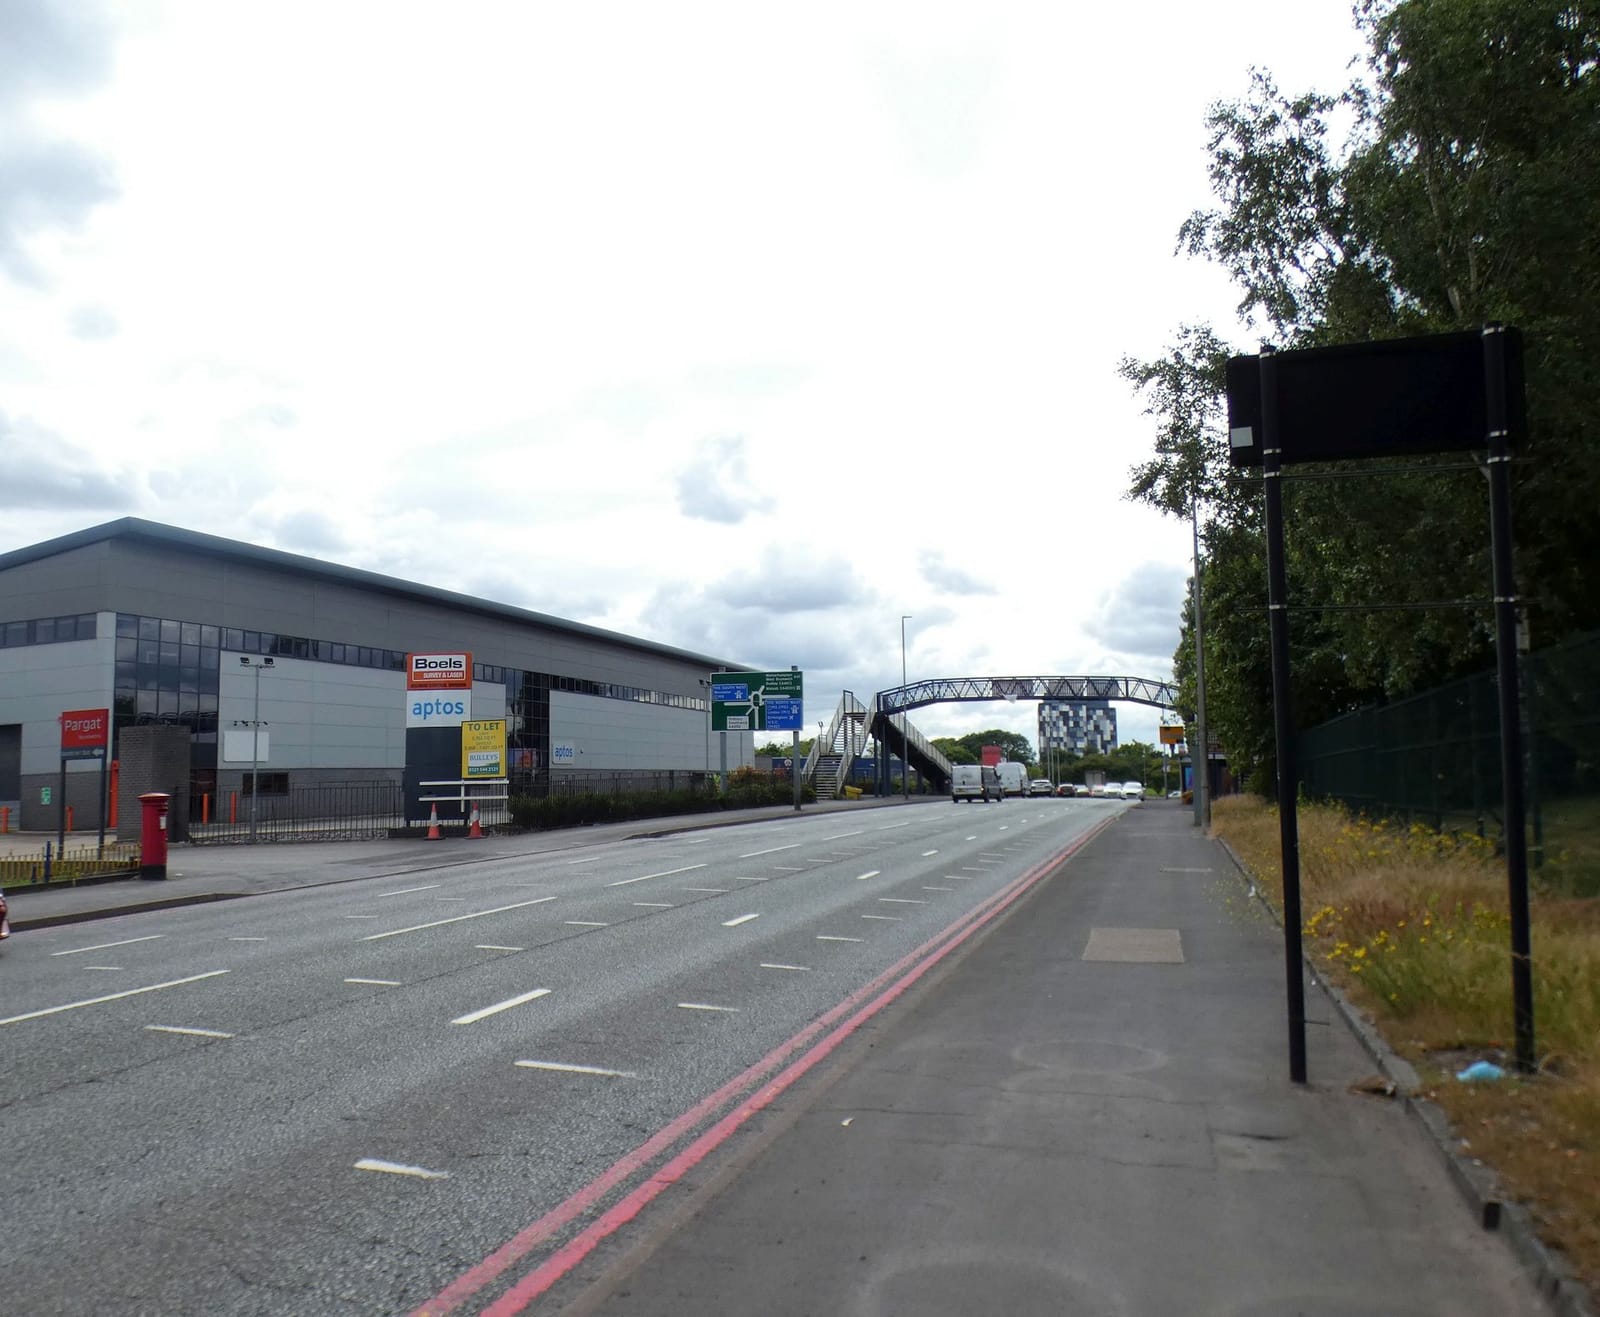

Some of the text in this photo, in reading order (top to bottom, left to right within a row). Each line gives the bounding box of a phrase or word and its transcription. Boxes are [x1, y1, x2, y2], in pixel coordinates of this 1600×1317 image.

[415, 657, 463, 669] Boels
[412, 698, 464, 720] aptos
[64, 717, 102, 733] Pargat
[467, 722, 500, 731] TO LET
[555, 744, 573, 761] aptos
